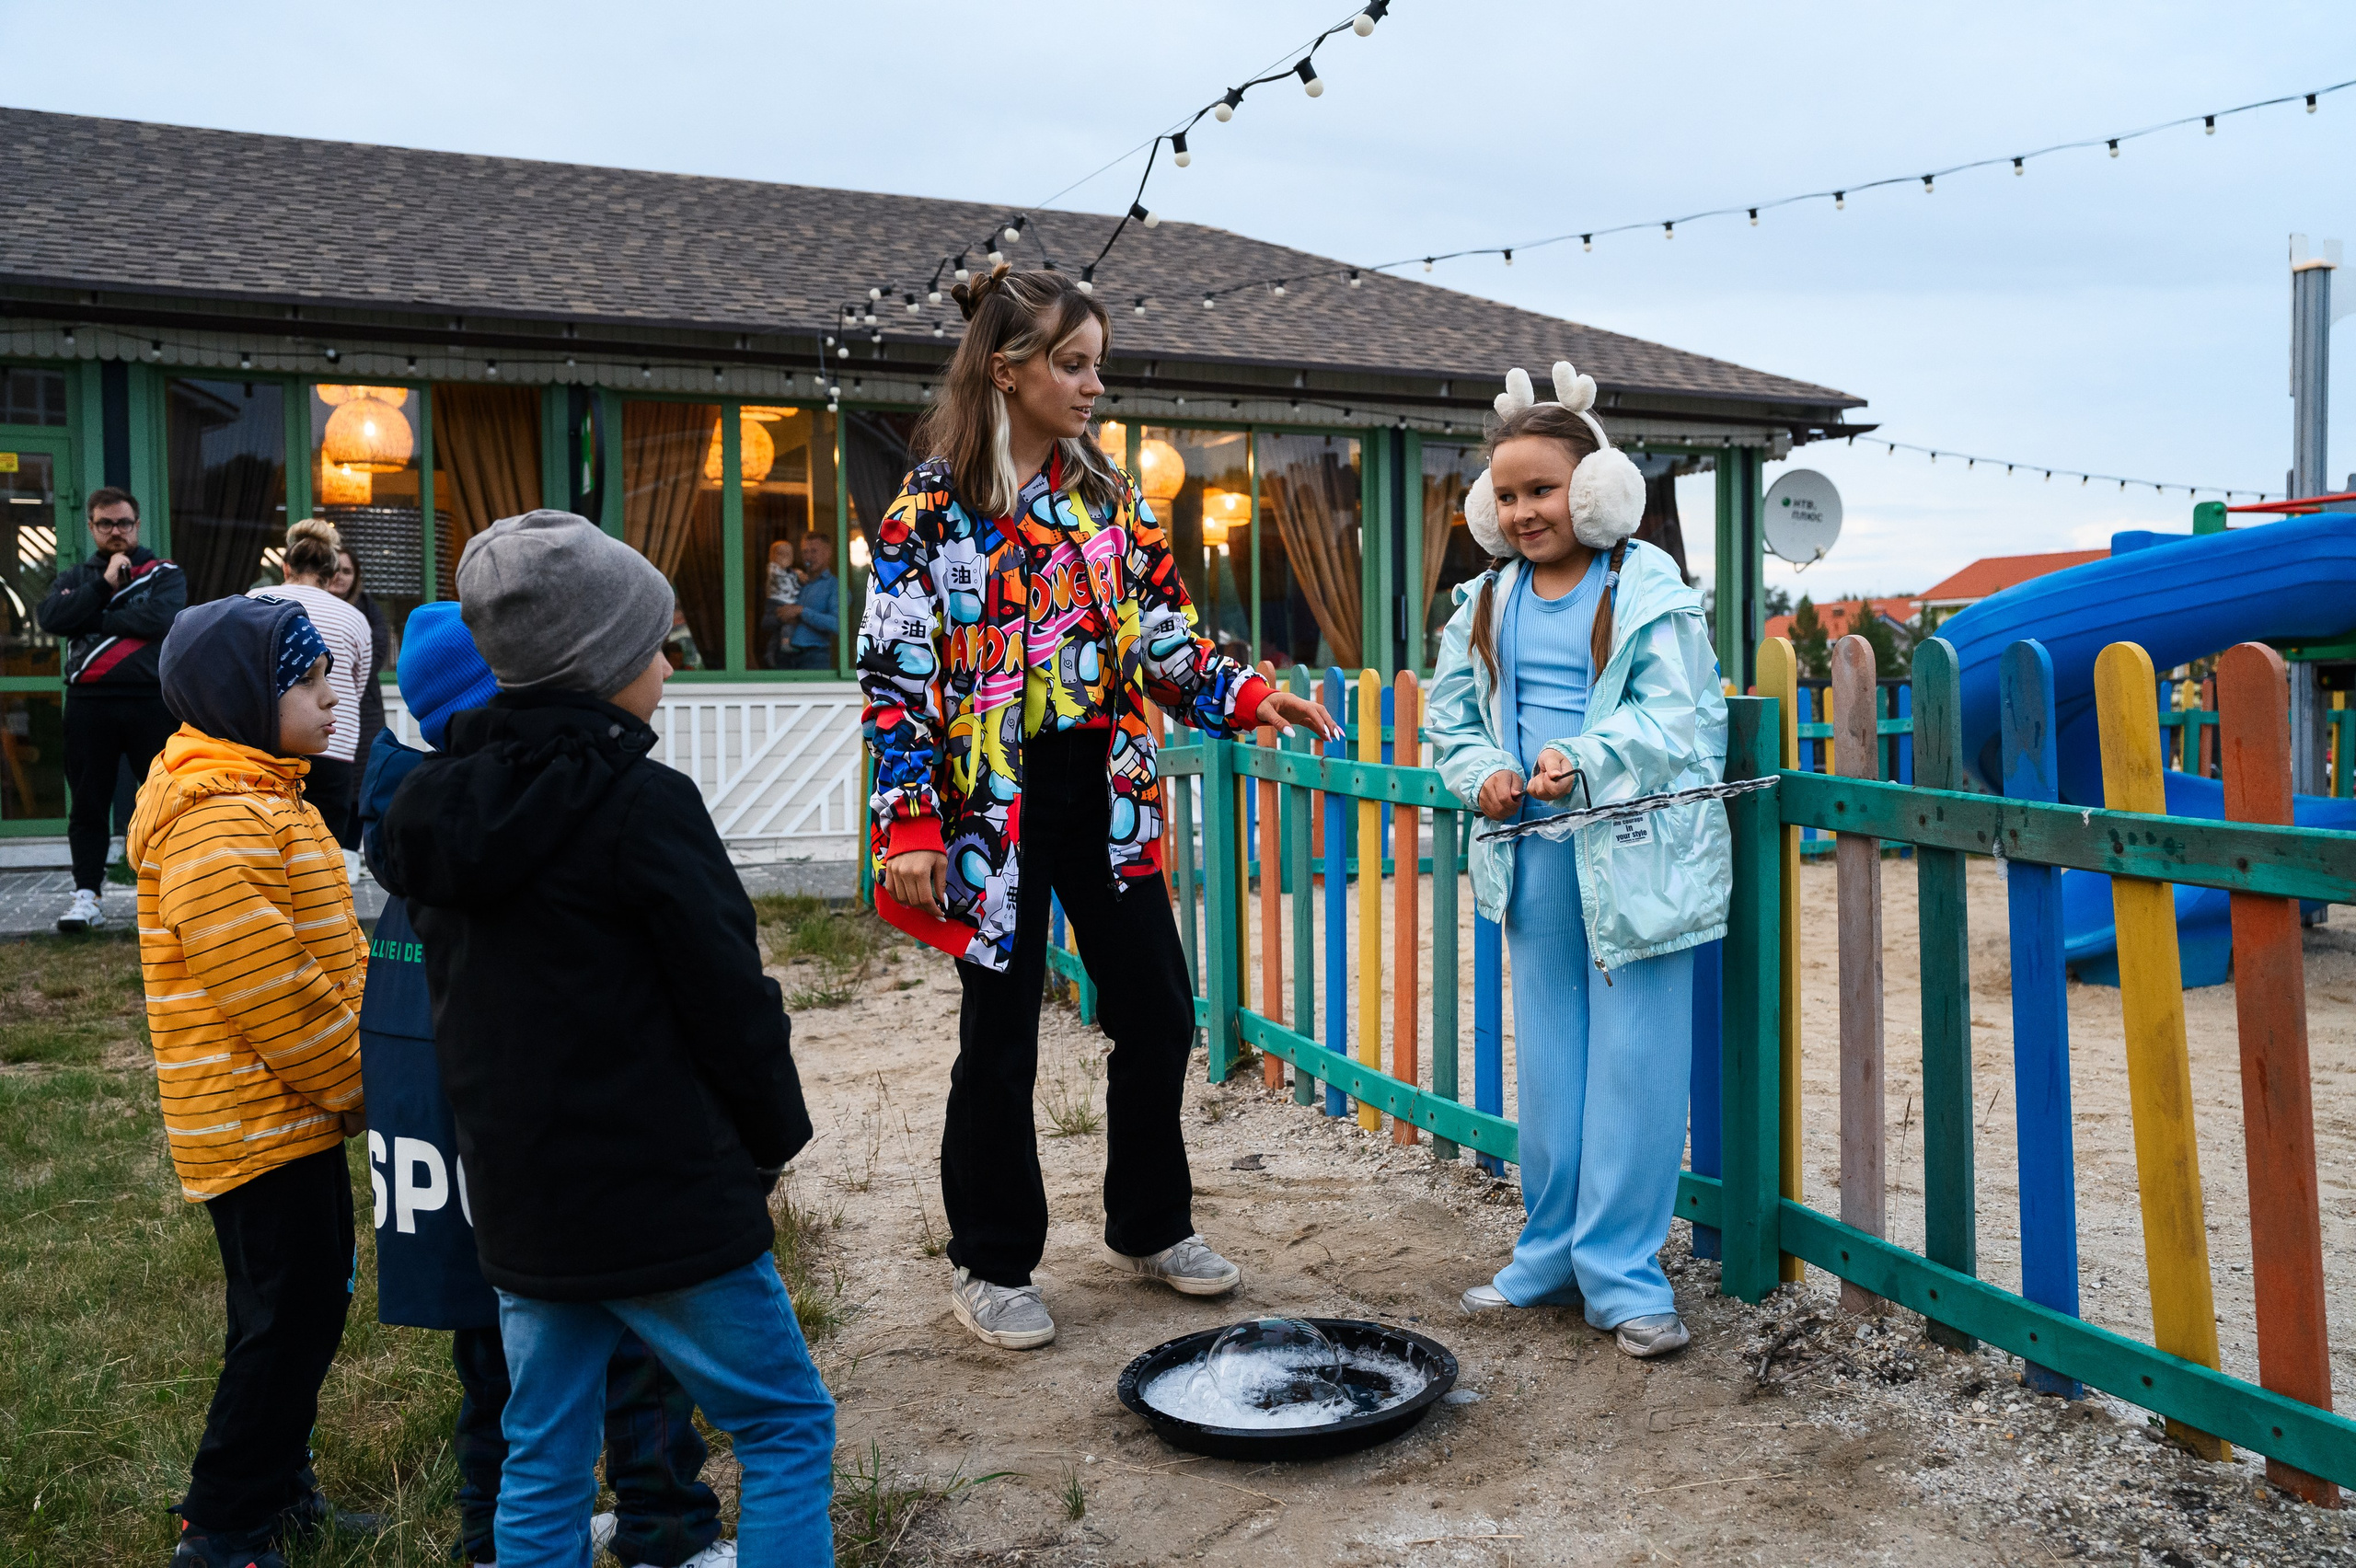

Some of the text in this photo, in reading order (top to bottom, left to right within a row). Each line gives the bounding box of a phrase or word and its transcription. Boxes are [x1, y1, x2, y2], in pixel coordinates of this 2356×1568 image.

[952, 565, 971, 584] 油
[901, 620, 927, 639] 油
[1616, 833, 1631, 841] your
[1632, 829, 1647, 838] style
